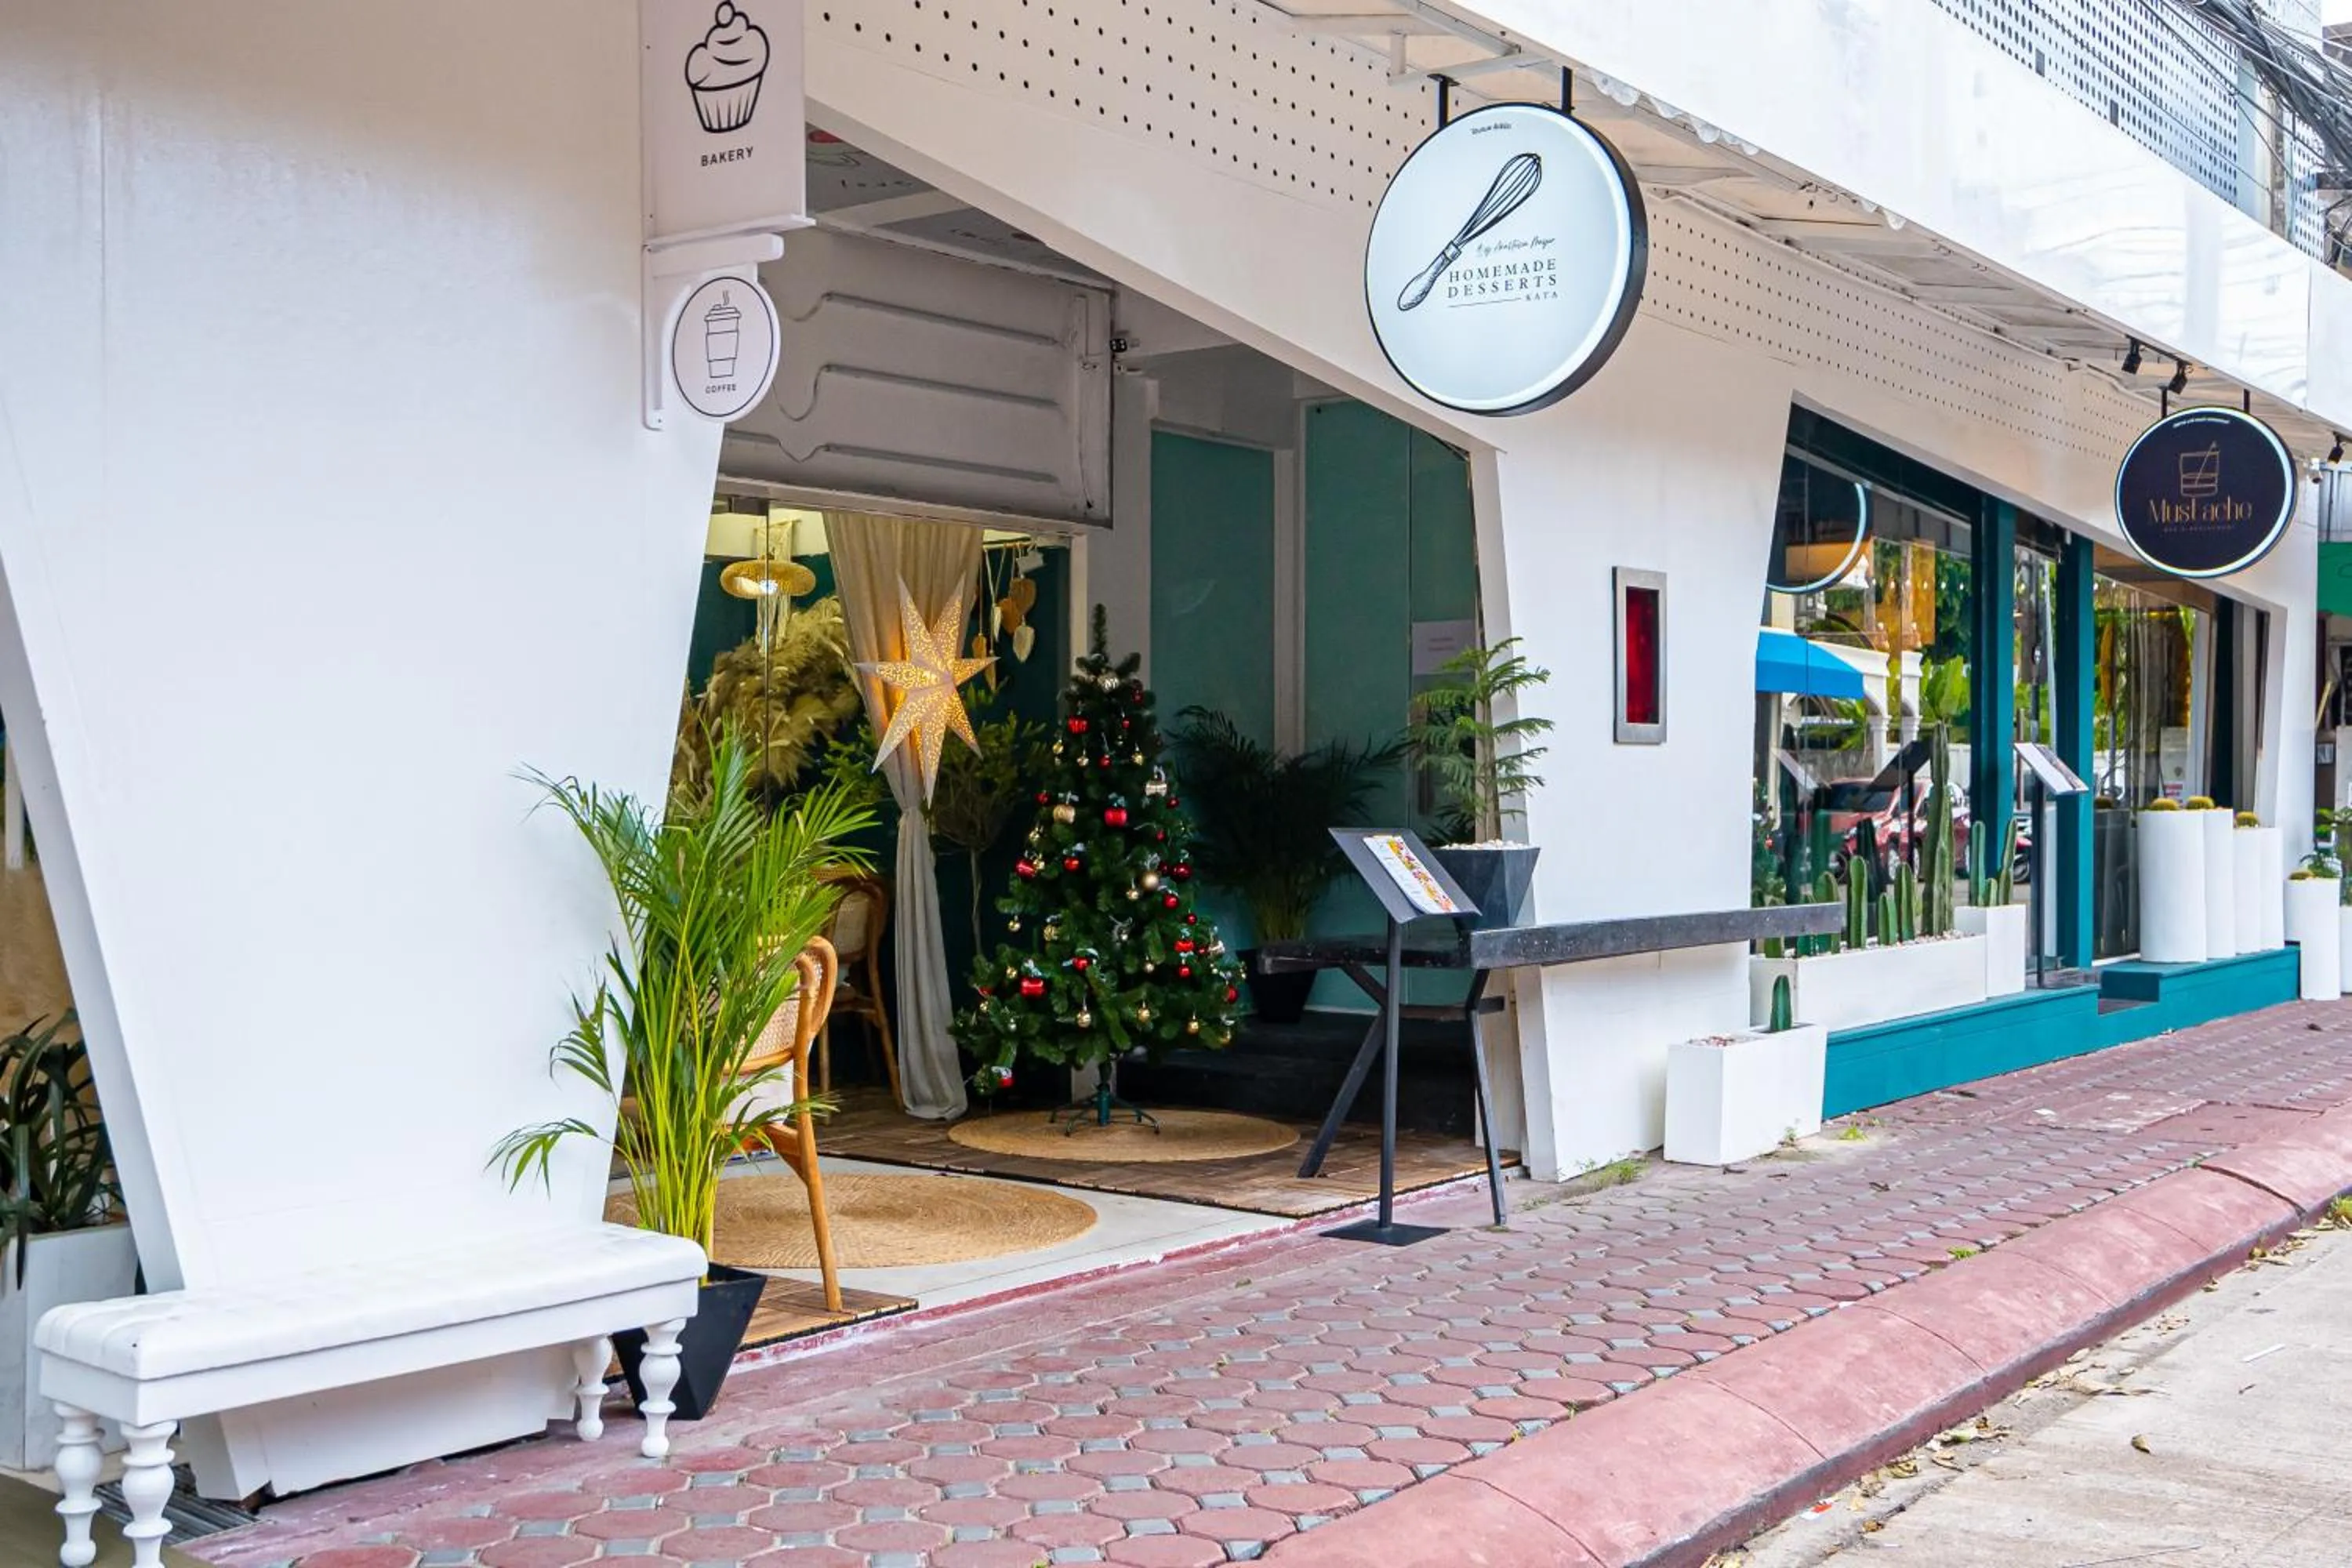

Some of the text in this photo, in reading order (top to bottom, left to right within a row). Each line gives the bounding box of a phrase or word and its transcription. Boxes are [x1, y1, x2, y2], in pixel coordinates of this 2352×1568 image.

[700, 146, 753, 167] BAKERY
[1449, 258, 1556, 283] HOMEMADE
[1448, 274, 1557, 299] DESSERTS
[705, 383, 737, 394] COFFEE
